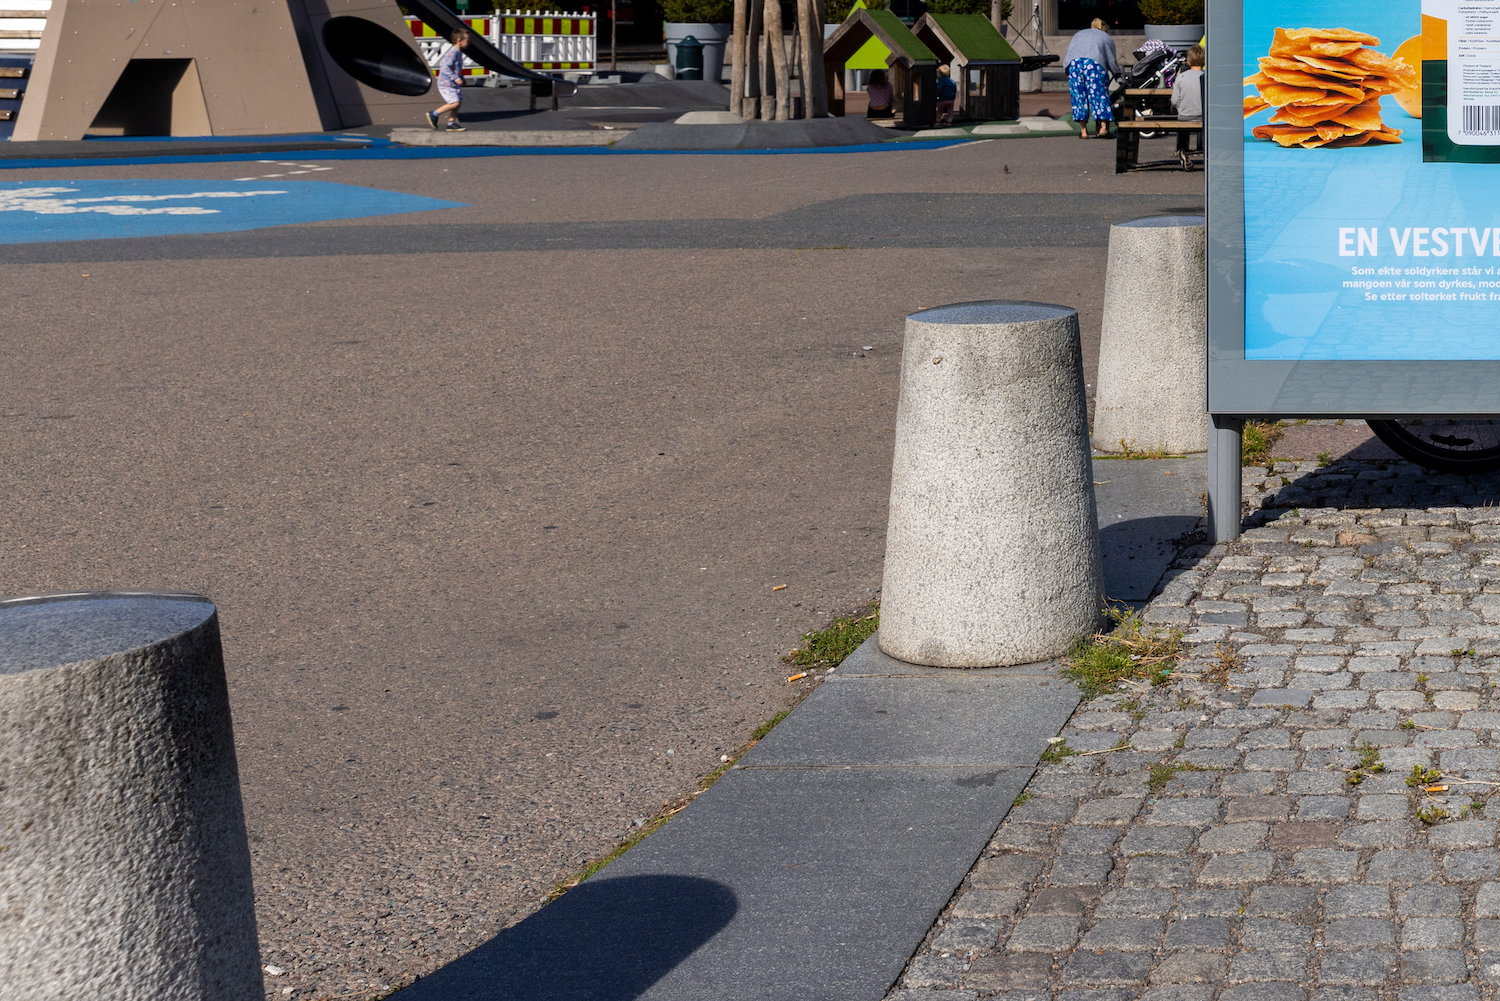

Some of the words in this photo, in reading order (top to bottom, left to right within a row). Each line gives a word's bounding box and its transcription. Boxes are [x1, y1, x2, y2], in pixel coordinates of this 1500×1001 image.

[1338, 227, 1378, 257] EN
[1351, 267, 1375, 275] Som
[1378, 266, 1401, 275] ekte
[1404, 266, 1459, 277] soldyrkere
[1462, 266, 1482, 275] står
[1485, 267, 1494, 275] vi
[1342, 280, 1392, 290] mangoen
[1394, 279, 1411, 288] vår
[1438, 279, 1476, 290] dyrkes,
[1364, 292, 1378, 301] Se
[1380, 292, 1407, 301] etter
[1409, 292, 1457, 301] soltørket
[1459, 292, 1487, 301] frukt
